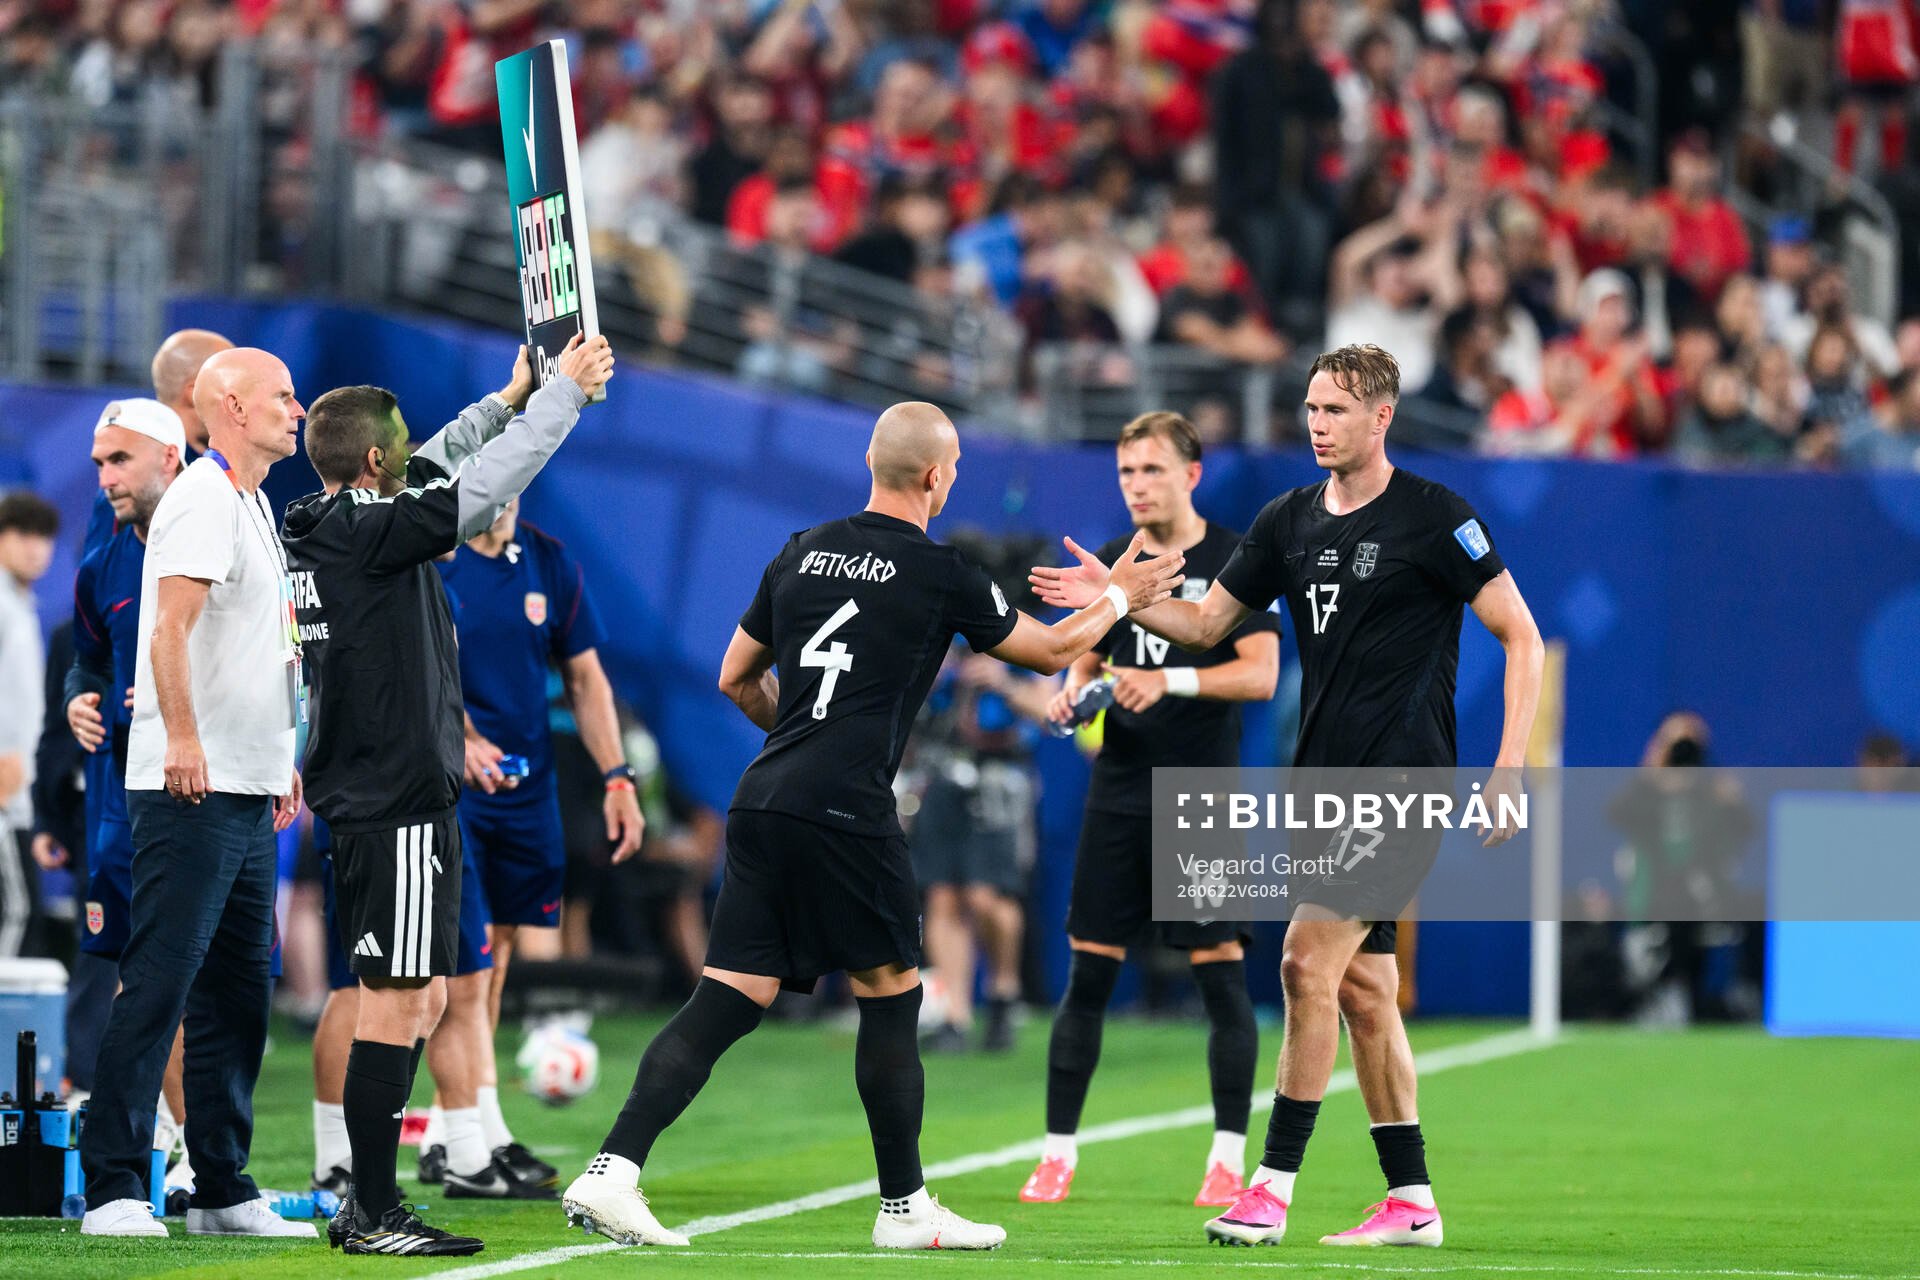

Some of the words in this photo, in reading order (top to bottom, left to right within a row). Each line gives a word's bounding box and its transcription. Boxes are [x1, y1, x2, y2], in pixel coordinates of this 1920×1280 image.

[798, 550, 897, 583] ØSTIGÅRD
[1305, 583, 1340, 635] 17
[799, 598, 860, 721] 4
[1333, 823, 1386, 872] 17
